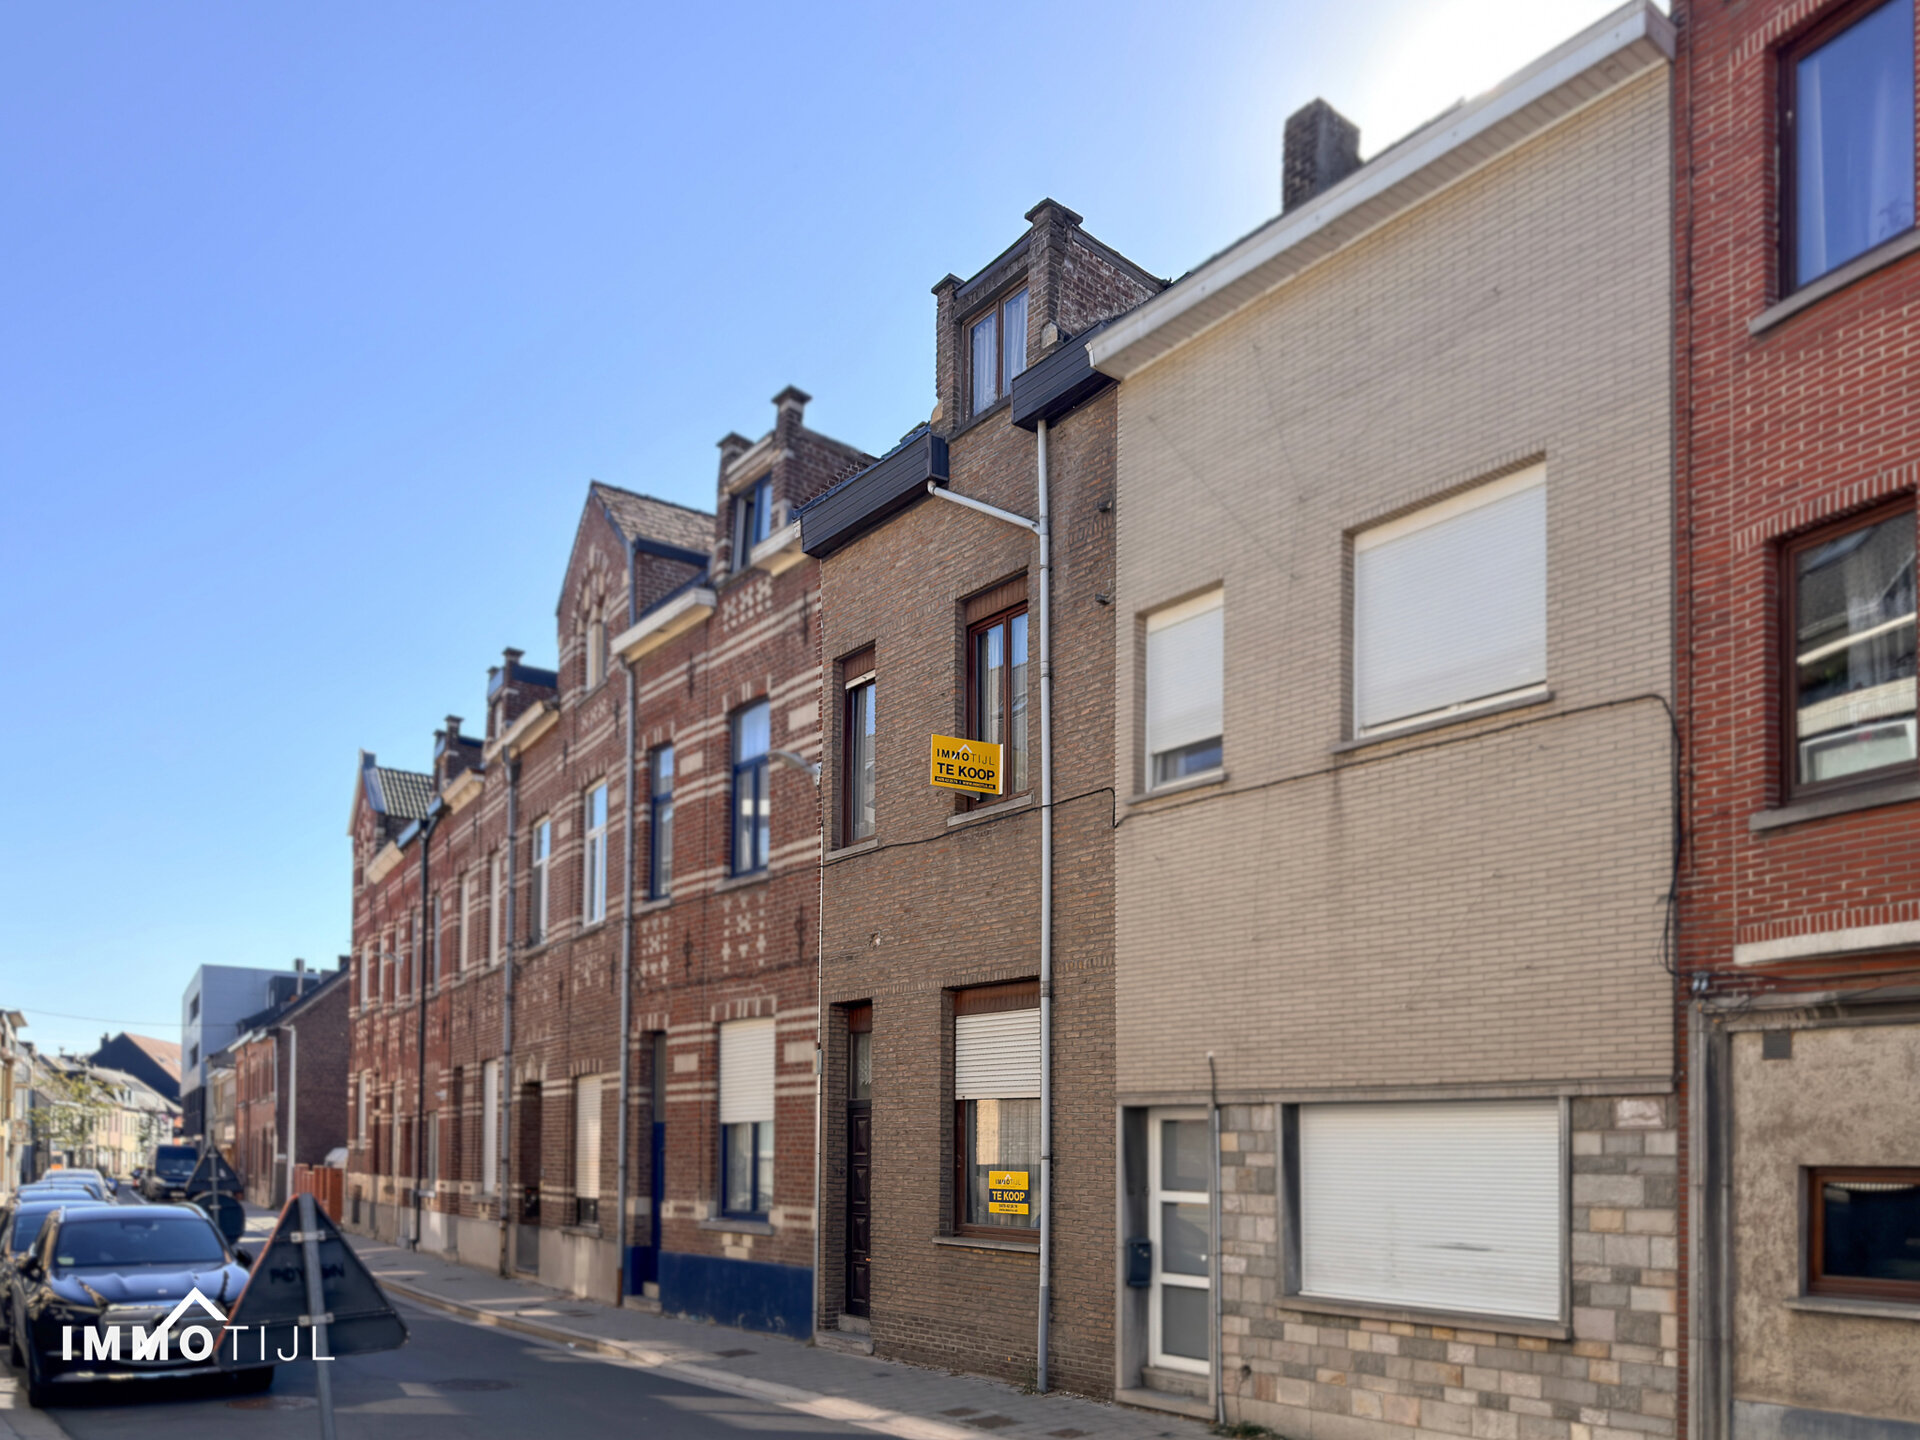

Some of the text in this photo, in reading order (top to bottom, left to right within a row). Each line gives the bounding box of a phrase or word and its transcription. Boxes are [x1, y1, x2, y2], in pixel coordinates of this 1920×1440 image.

[937, 762, 995, 781] TE KOOP
[992, 1191, 1025, 1201] TE KOOP
